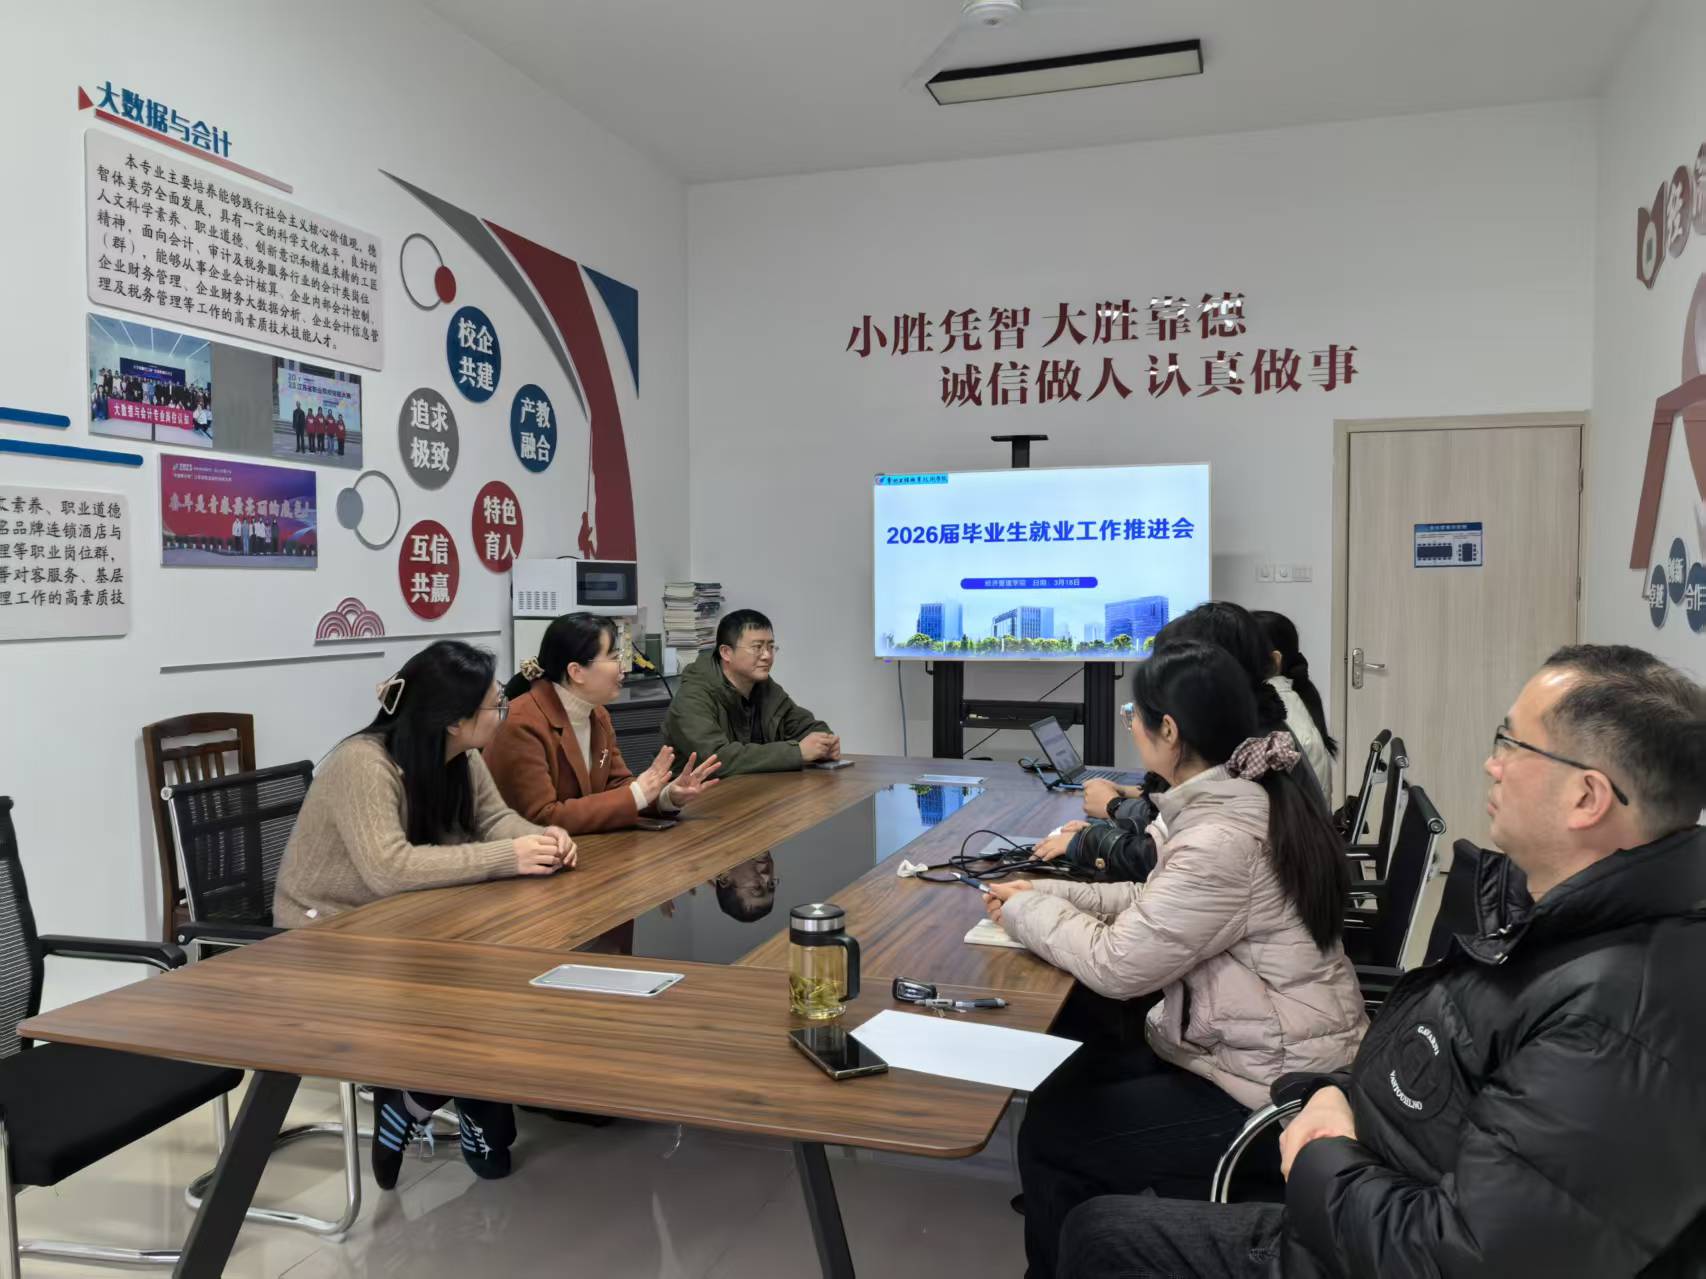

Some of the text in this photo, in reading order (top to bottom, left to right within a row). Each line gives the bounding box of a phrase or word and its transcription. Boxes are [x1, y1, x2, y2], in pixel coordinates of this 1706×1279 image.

[96, 81, 232, 157] 大数据与会计
[458, 317, 494, 355] 校企
[846, 291, 1247, 358] 小胜凭智 大胜靠德
[459, 356, 494, 392] 共建
[940, 344, 1359, 409] 诚信做人 认真做事
[410, 398, 449, 432] 追求
[520, 397, 550, 429] 产教
[410, 436, 450, 472] 极致
[520, 431, 550, 463] 融合
[483, 496, 517, 526] 特色
[484, 531, 518, 561] 育人
[886, 517, 1195, 545] 2026届毕业生就业工作推进会
[410, 534, 449, 566] 互信
[411, 572, 450, 604] 共赢
